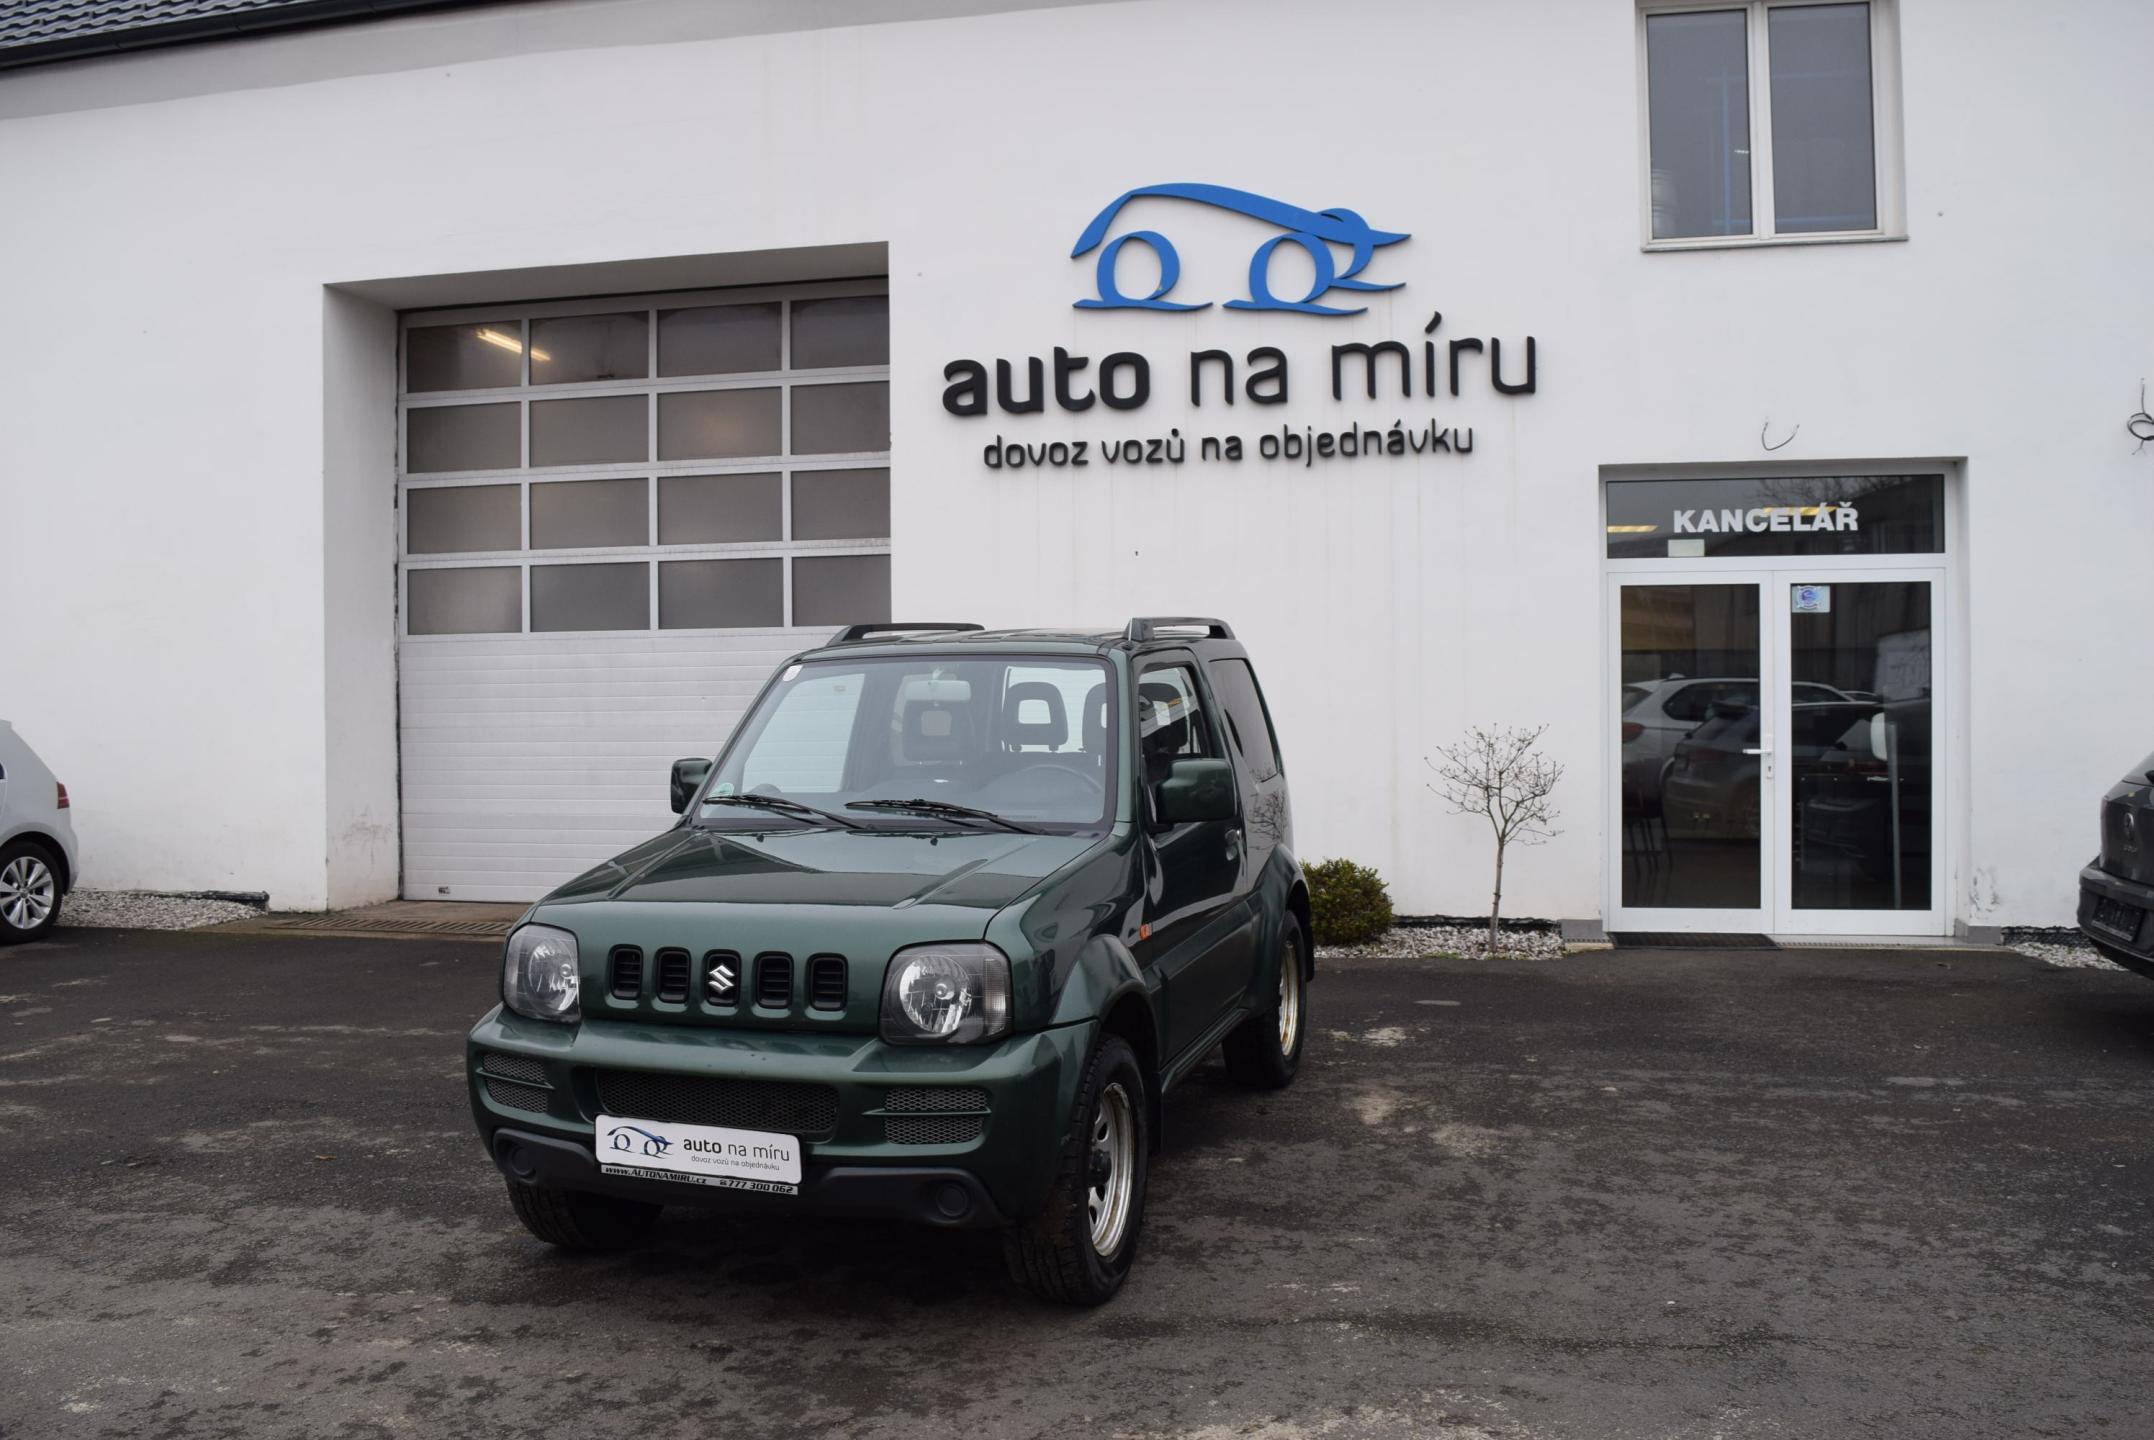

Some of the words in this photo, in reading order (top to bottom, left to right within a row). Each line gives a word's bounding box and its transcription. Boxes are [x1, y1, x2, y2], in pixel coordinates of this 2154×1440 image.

[942, 346, 1150, 416] auto
[1190, 346, 1288, 406] na
[1331, 310, 1536, 402] míru
[983, 435, 1089, 470] dovoz
[1101, 428, 1185, 464] vozů
[1201, 433, 1243, 462] na
[1260, 418, 1473, 467] objednávku
[1673, 501, 1859, 533] KANCELÁŘ
[683, 1138, 722, 1154] auto
[728, 1144, 747, 1157] na
[753, 1144, 790, 1161] míru
[691, 1155, 711, 1164] dovoz
[741, 1160, 780, 1171] objednávku
[750, 1181, 770, 1191] 300
[771, 1184, 794, 1194] 062
